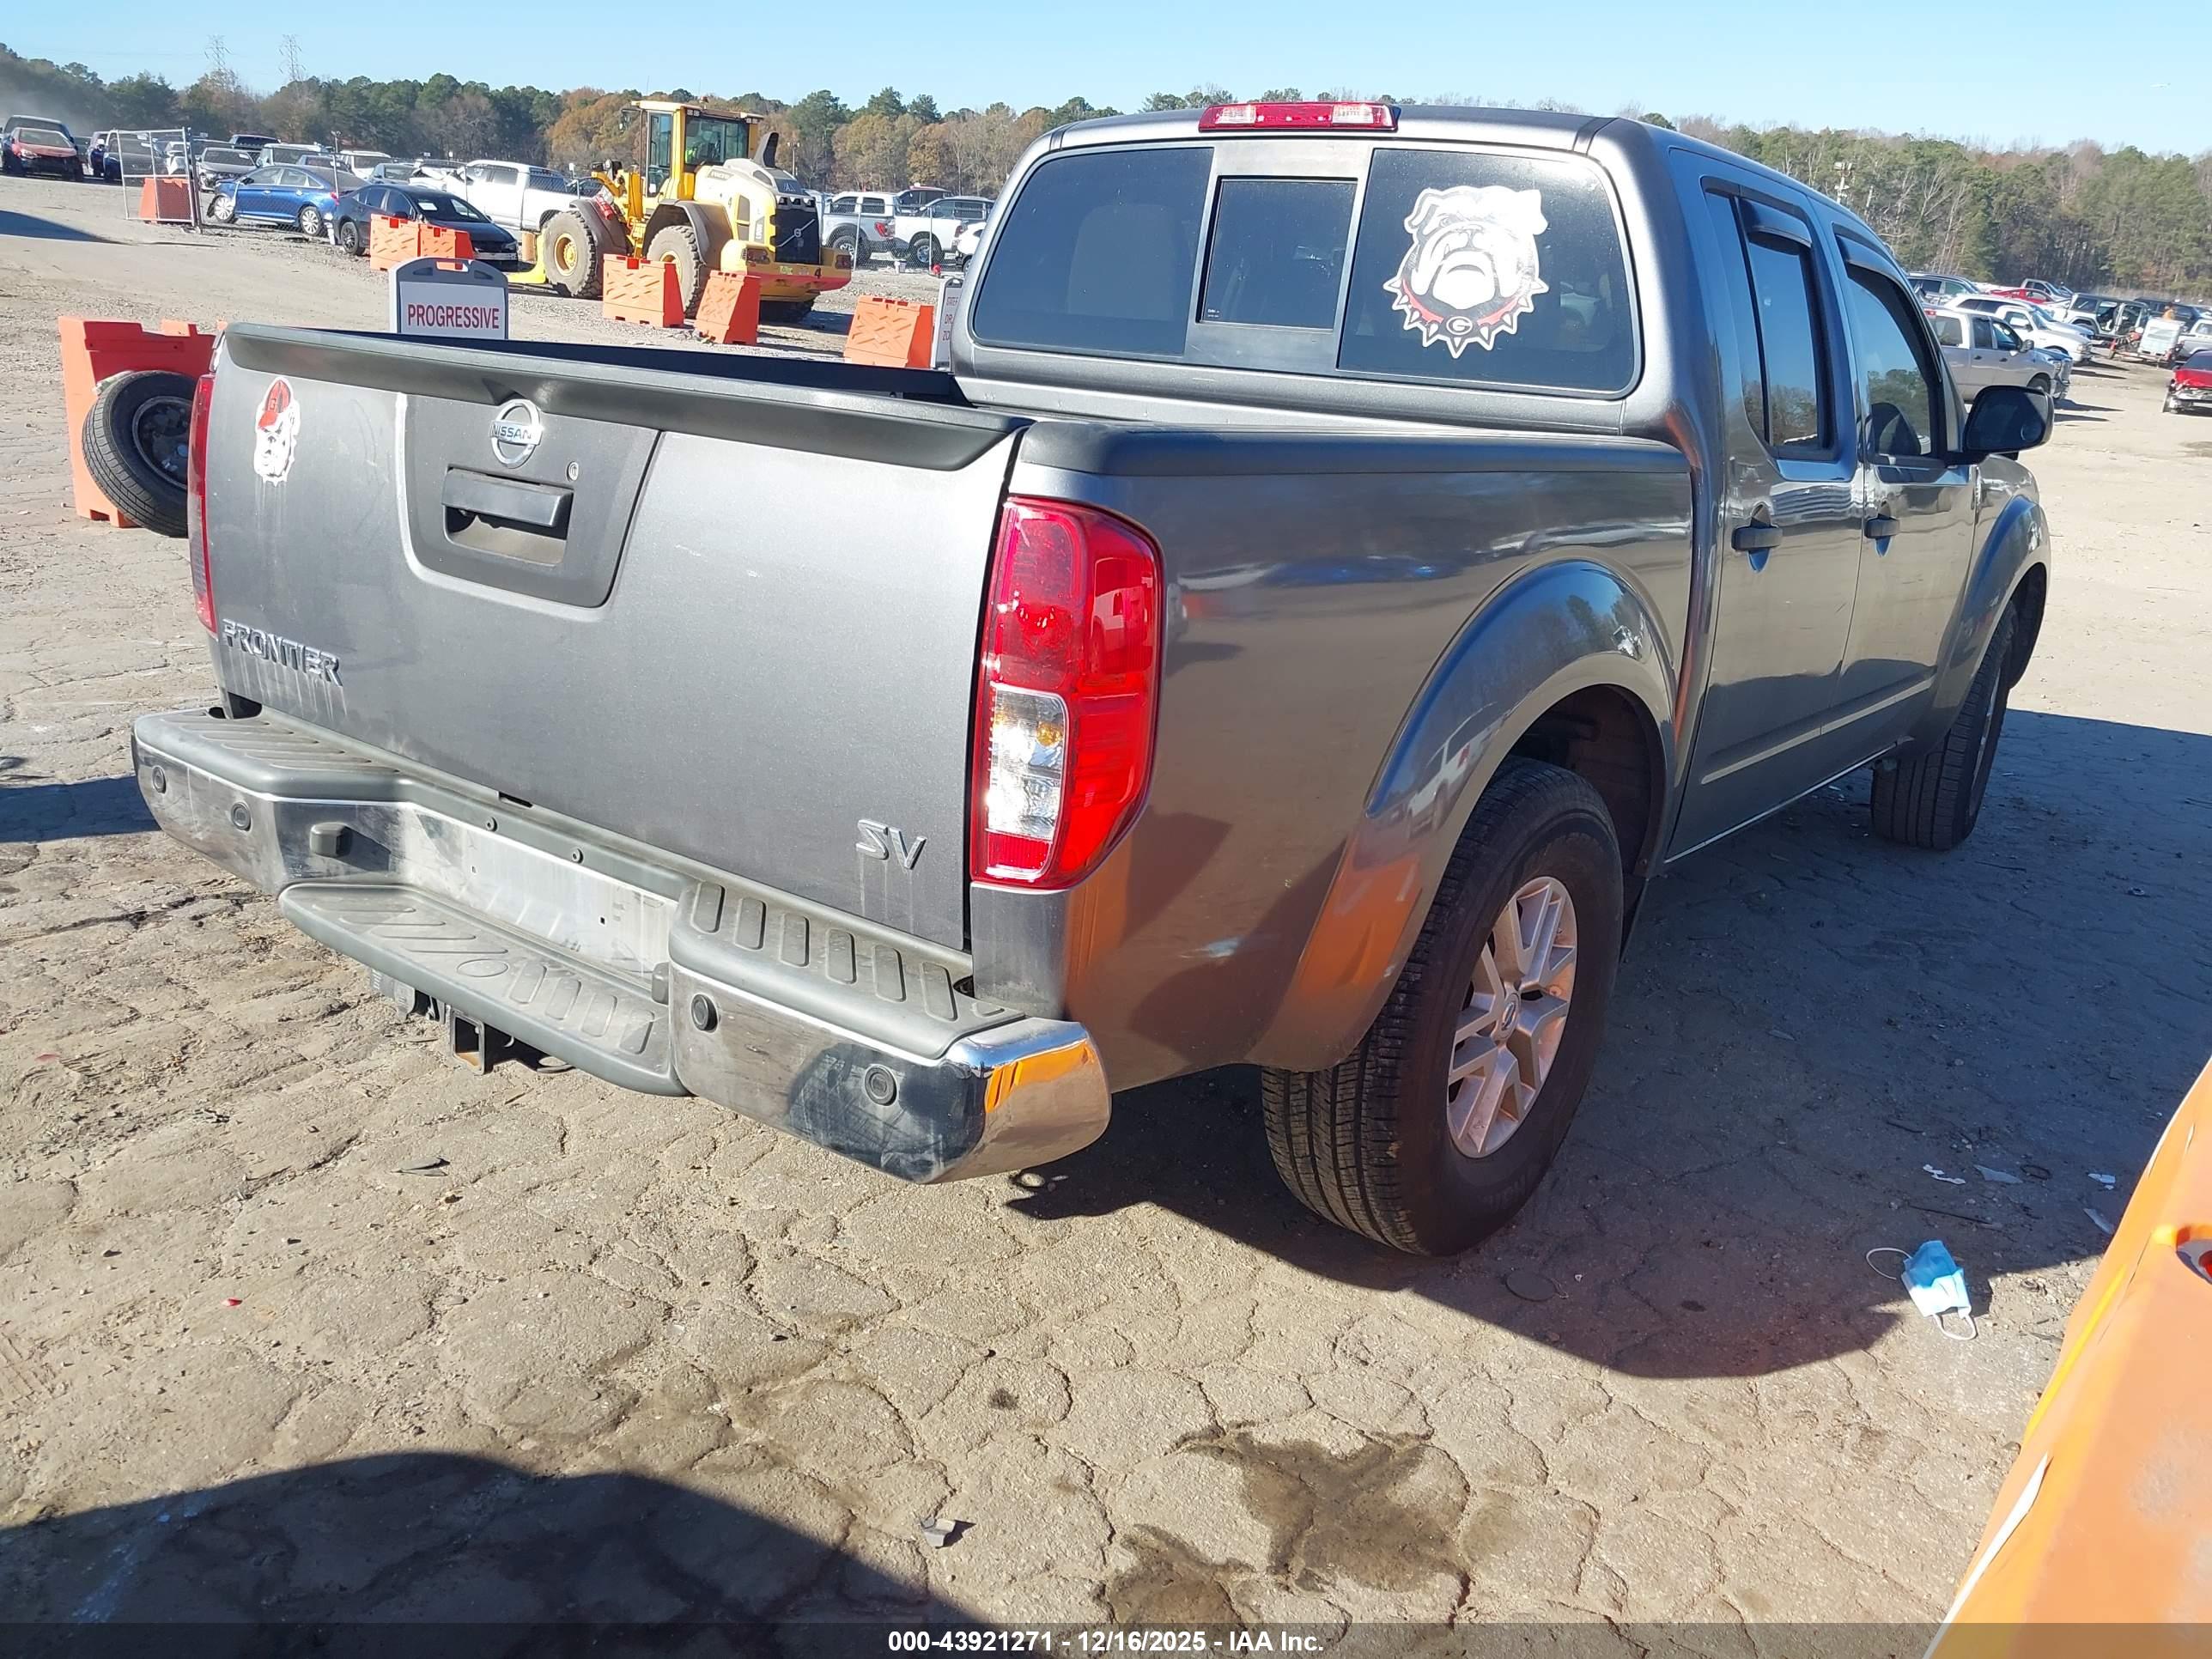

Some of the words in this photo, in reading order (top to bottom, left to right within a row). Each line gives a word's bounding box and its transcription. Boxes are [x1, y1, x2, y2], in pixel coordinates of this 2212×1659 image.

[814, 267, 822, 280] 4
[408, 304, 500, 329] PROGRESSIVE
[492, 425, 532, 440] NISSAN
[222, 618, 343, 687] FRONTIER
[855, 819, 927, 870] SV
